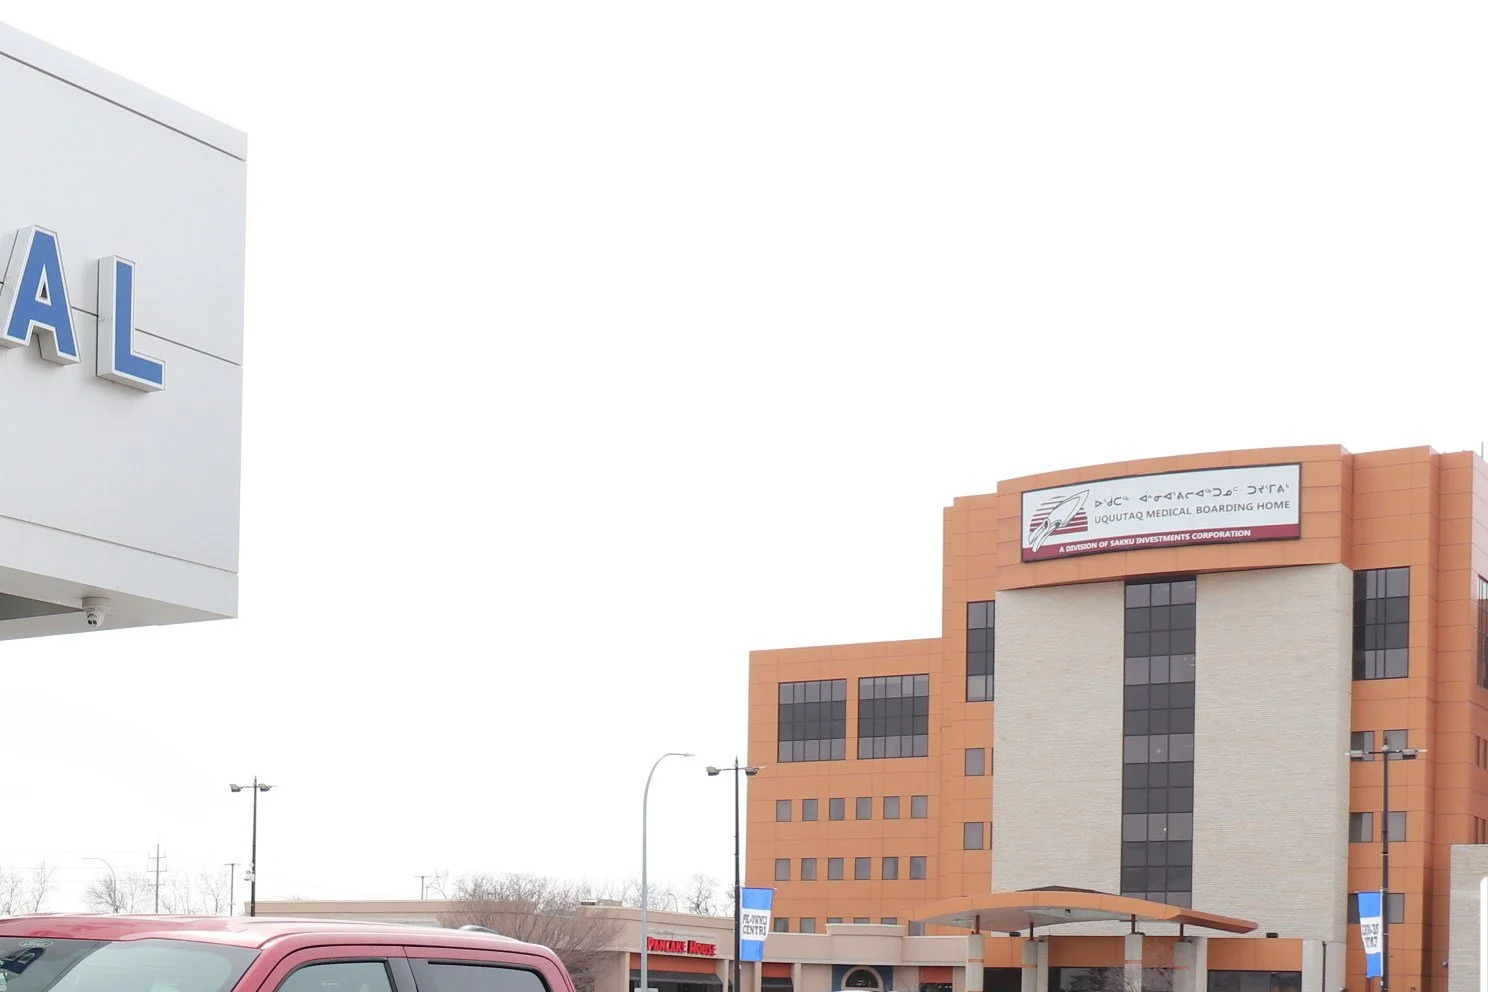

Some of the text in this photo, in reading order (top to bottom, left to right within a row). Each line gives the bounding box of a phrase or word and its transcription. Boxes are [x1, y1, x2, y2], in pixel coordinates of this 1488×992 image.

[1094, 500, 1290, 524] UQUUTAQ MEDICAL BOARDING HOME
[1066, 542, 1098, 552] DIVISION
[1099, 540, 1109, 548] OF
[1110, 537, 1135, 547] SAKKU
[1136, 533, 1190, 544] INVESTMENTS
[1191, 529, 1251, 540] CORPORATION
[687, 940, 717, 957] HOUSE
